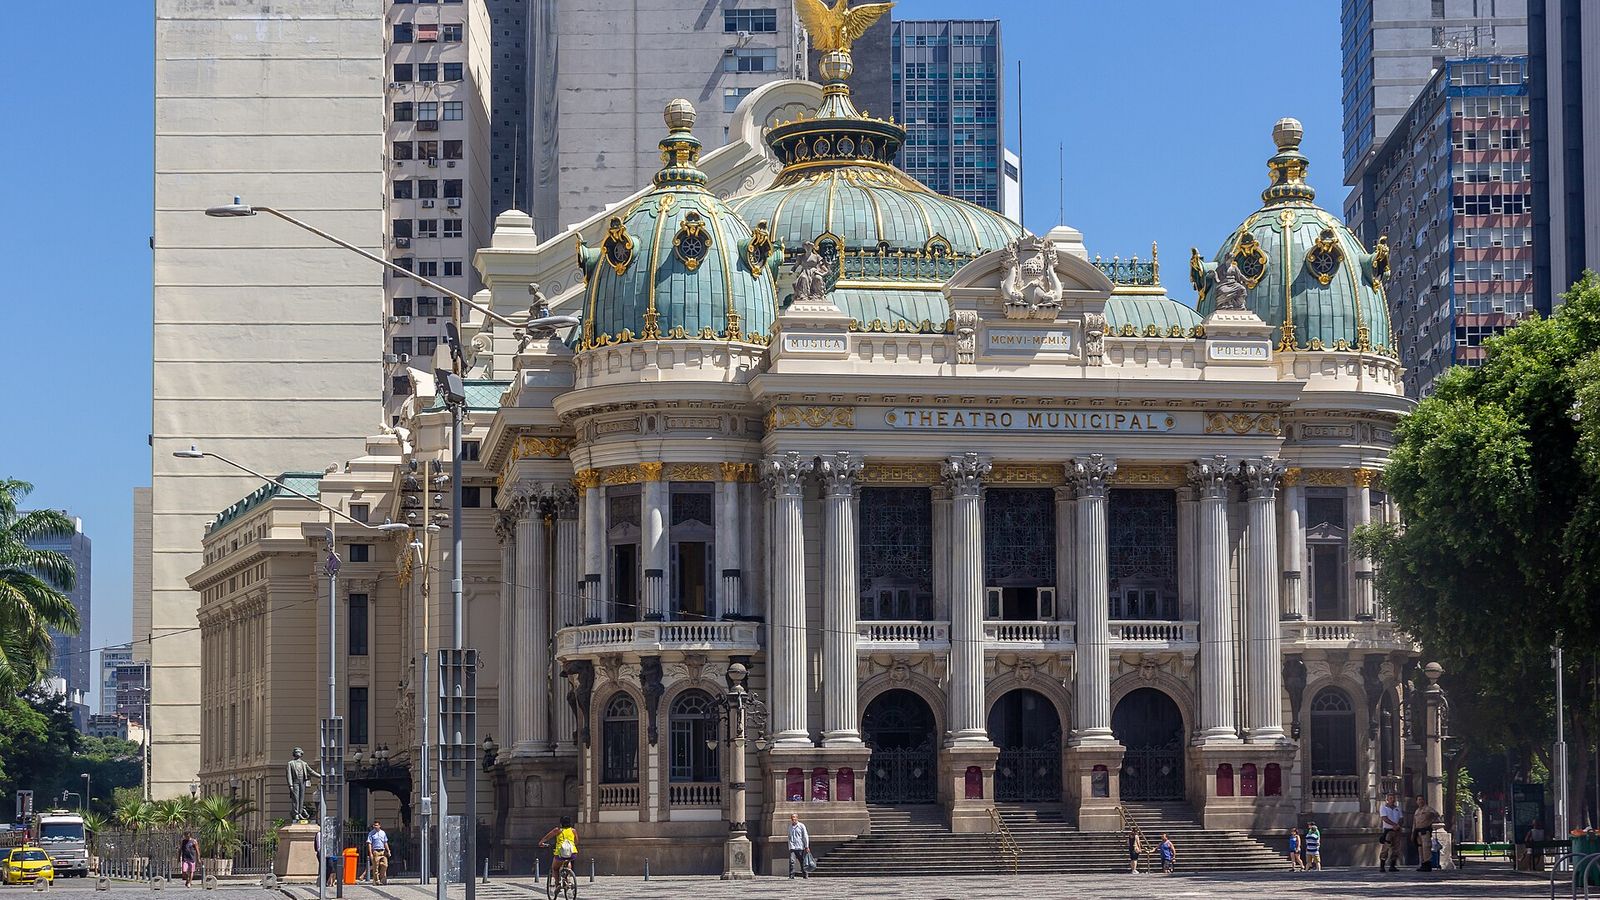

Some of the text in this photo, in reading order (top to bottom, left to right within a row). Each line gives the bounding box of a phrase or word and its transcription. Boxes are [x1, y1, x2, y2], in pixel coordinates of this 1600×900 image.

[791, 339, 840, 348] MUSICA
[991, 335, 1068, 345] MCMVI-MCMIX
[1217, 346, 1262, 356] POESIA
[904, 411, 1158, 430] THEATRO MUNICIPAL
